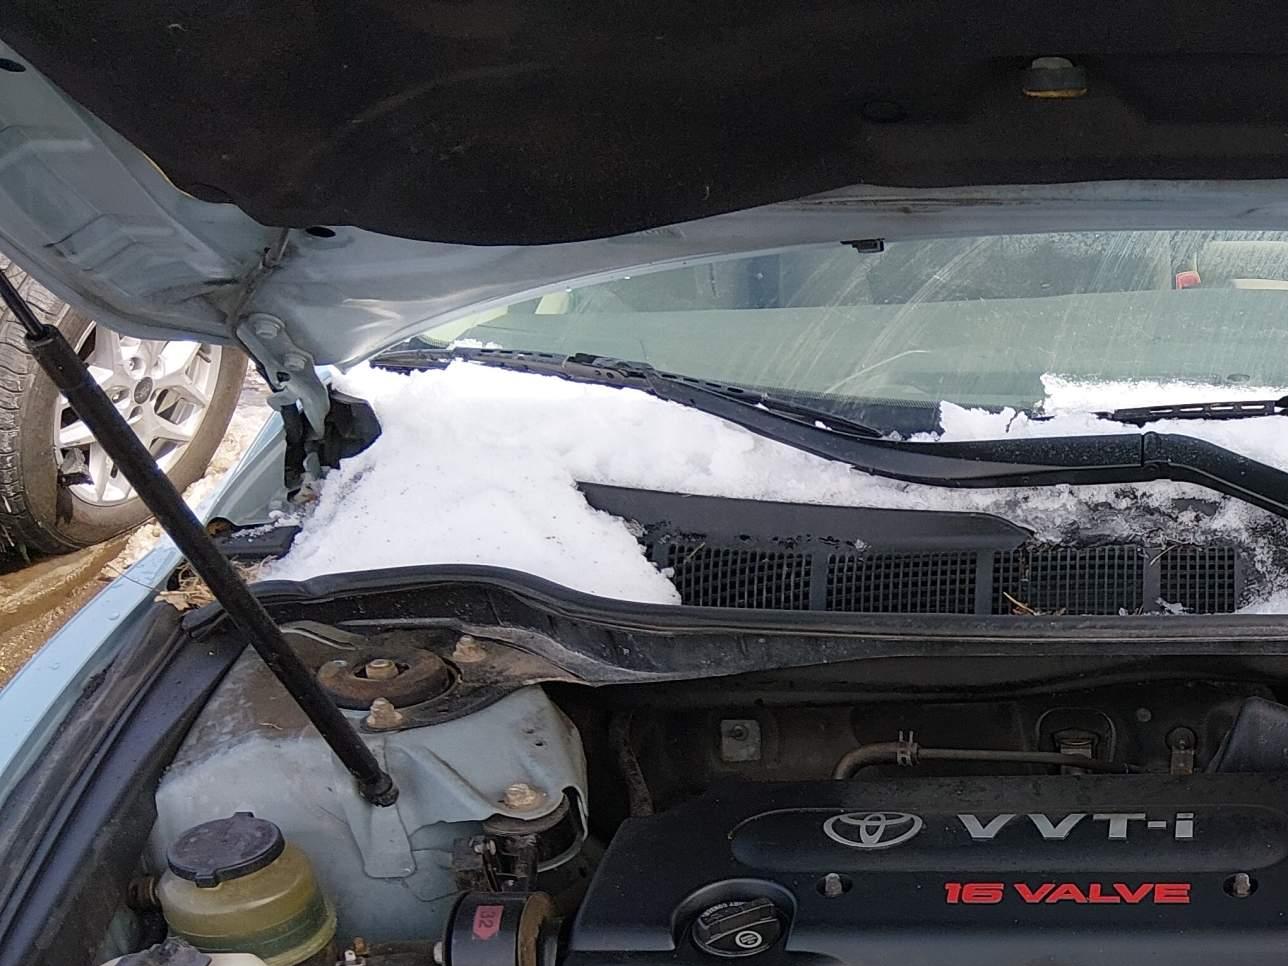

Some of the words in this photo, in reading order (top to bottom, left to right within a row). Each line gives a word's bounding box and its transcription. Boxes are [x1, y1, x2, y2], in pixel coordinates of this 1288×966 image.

[957, 813, 1194, 840] VVT-i
[944, 882, 1005, 904] 16
[1013, 882, 1191, 904] VALVE
[478, 911, 496, 929] 32
